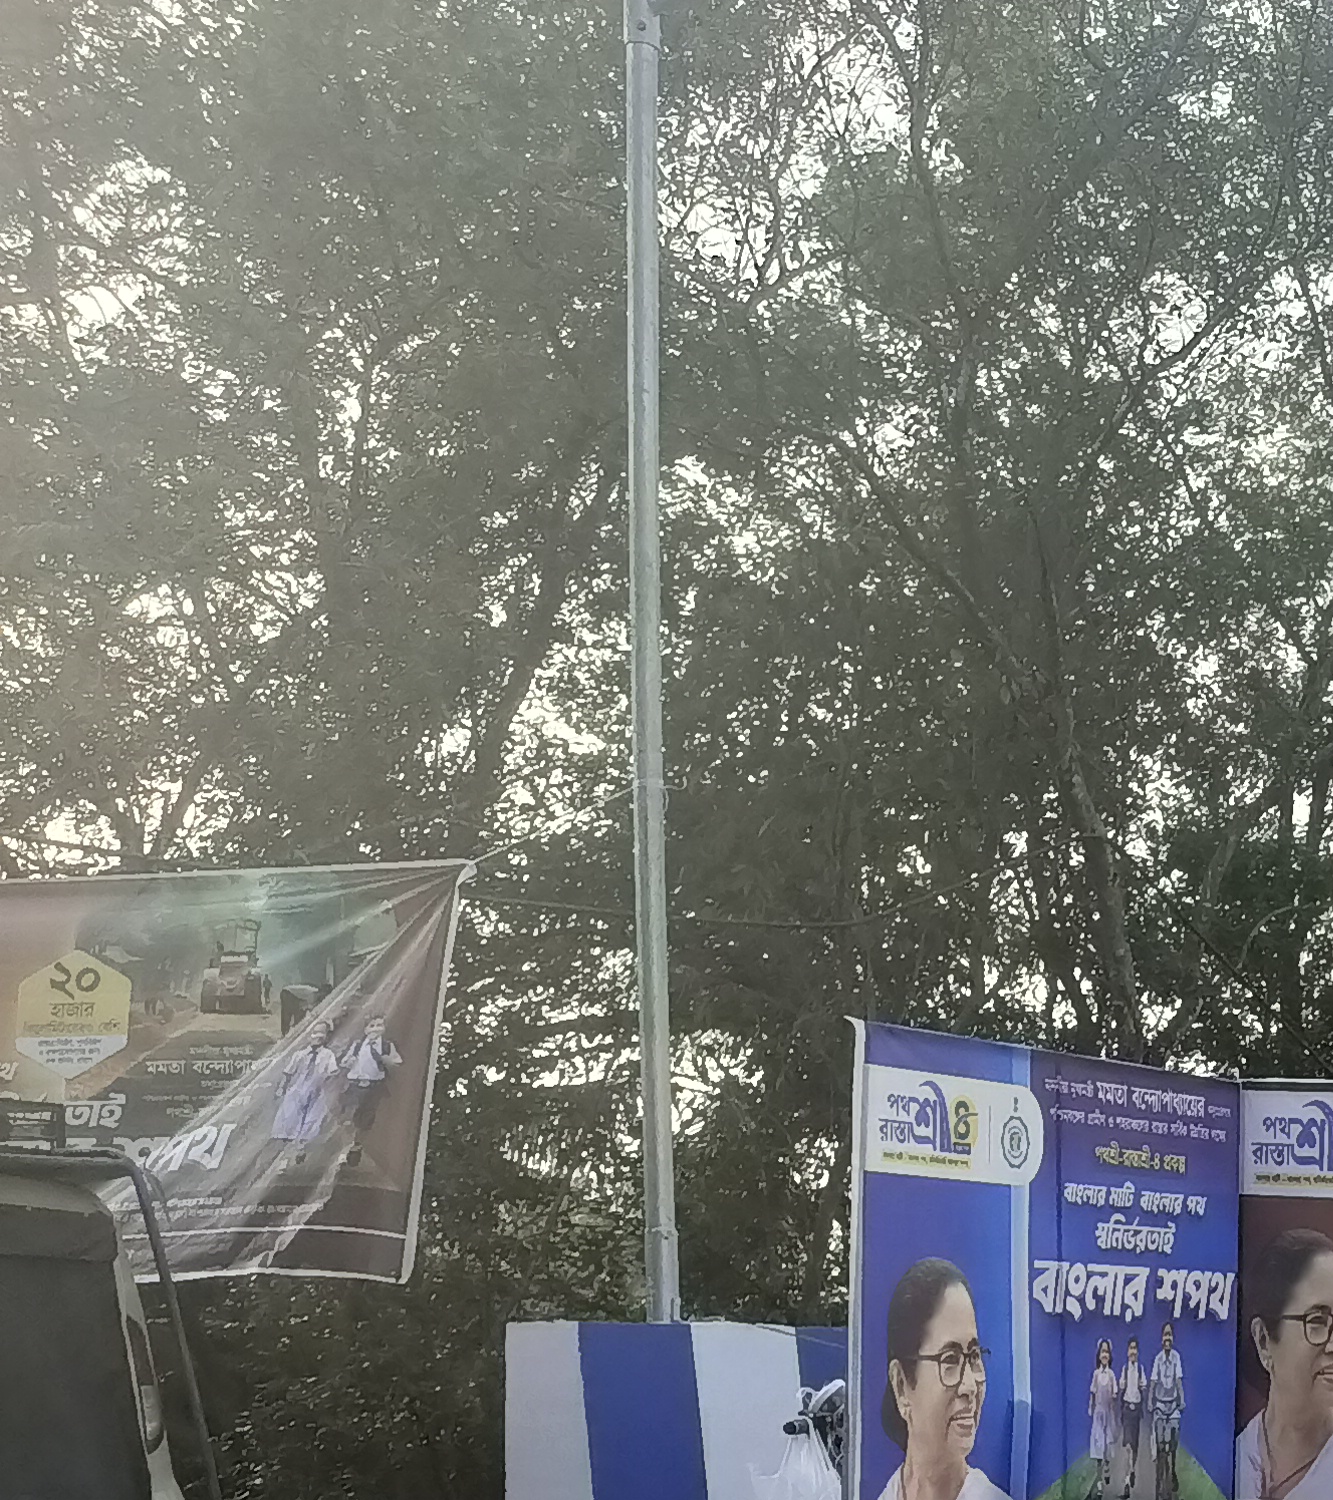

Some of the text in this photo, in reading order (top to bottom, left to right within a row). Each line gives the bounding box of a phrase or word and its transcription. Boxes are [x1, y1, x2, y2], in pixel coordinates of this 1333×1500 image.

[50, 962, 101, 1000] ২০
[145, 1060, 187, 1075] মমতা
[1096, 1081, 1128, 1107] মমতা
[1064, 1181, 1207, 1216] বাংলার মাটি বাংলার পথ
[1095, 1212, 1176, 1254] স্বনির্ভরতাই
[1033, 1259, 1236, 1323] বাংলার শপথ
